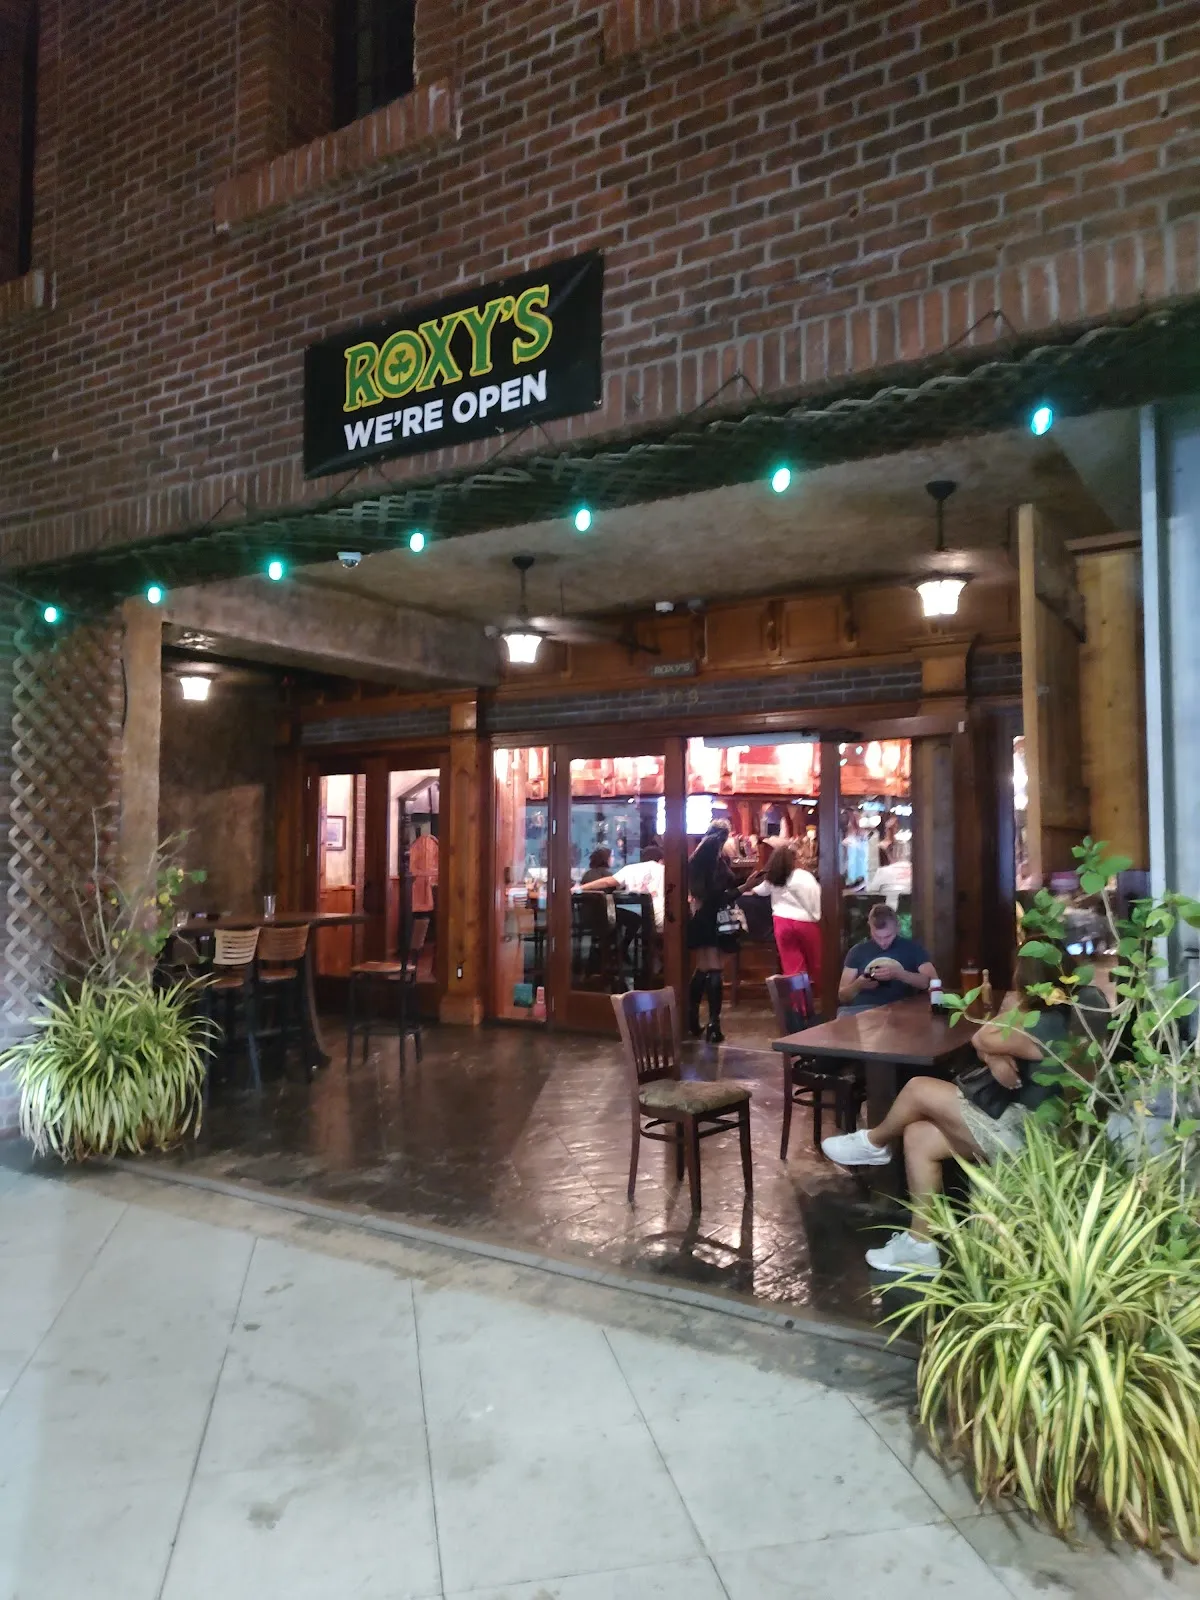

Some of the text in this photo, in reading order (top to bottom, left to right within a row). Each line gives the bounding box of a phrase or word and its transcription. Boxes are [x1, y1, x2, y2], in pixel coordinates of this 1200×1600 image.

[343, 284, 553, 412] ROXY'S
[344, 369, 547, 451] WE'RE OPEN
